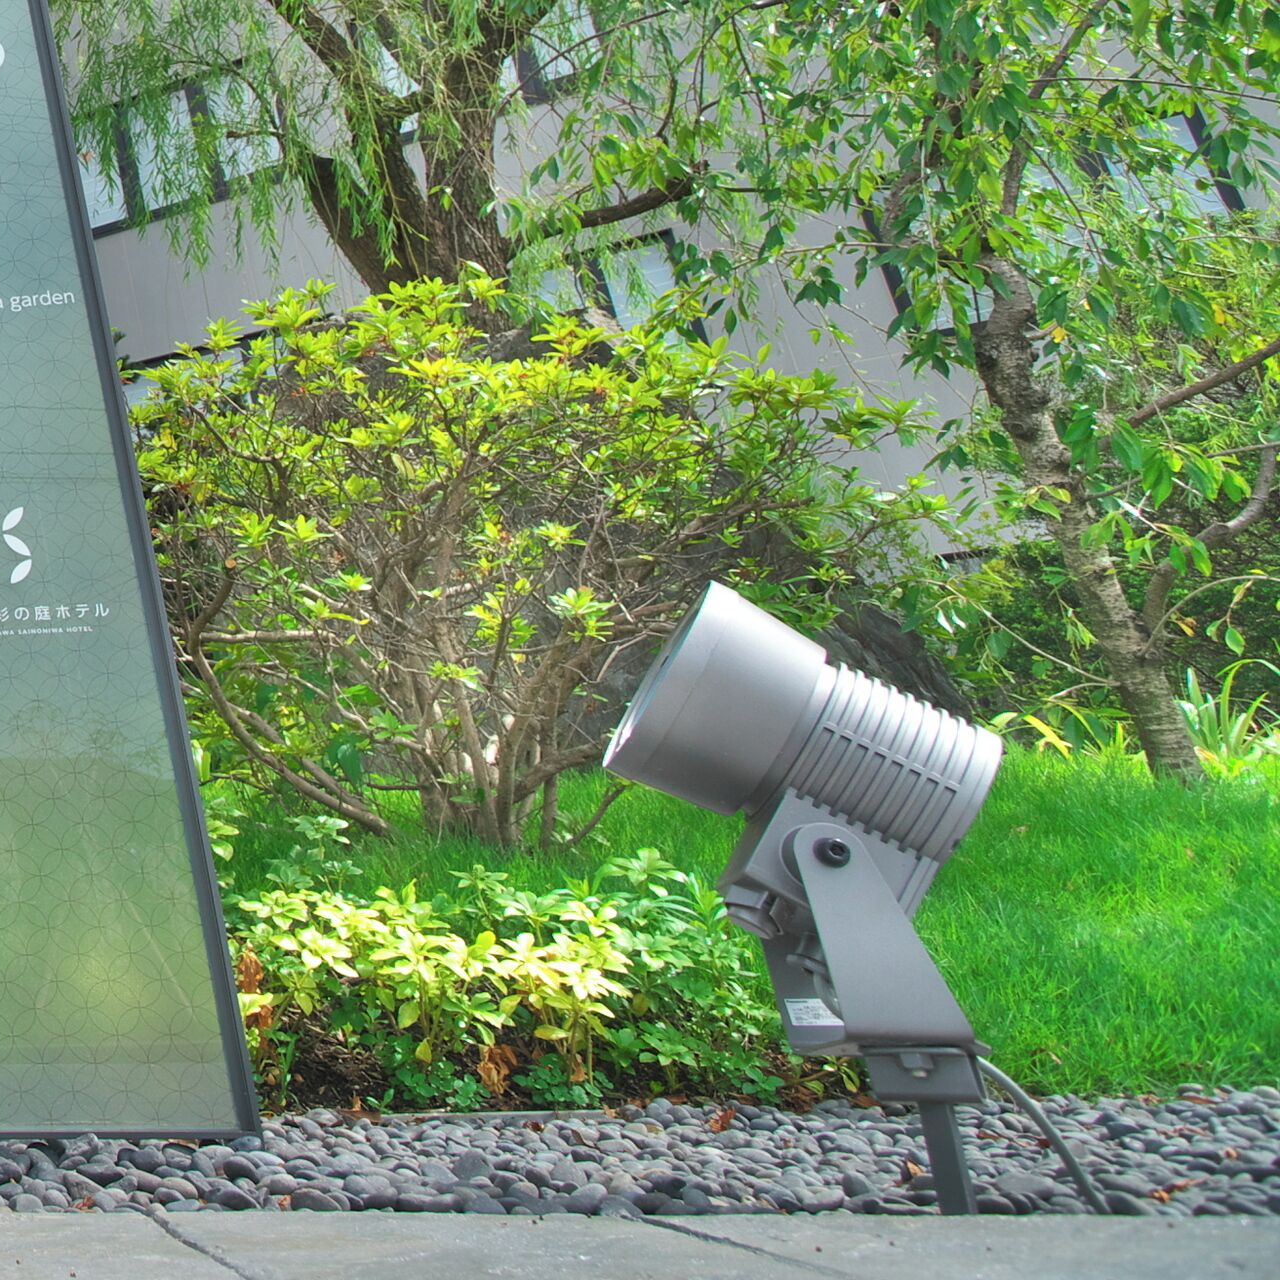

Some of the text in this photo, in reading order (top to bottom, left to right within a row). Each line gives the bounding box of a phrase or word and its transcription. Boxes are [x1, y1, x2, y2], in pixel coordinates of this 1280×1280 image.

[10, 290, 75, 312] garden
[18, 626, 64, 635] SAINONIWA
[67, 625, 93, 633] HOTEL
